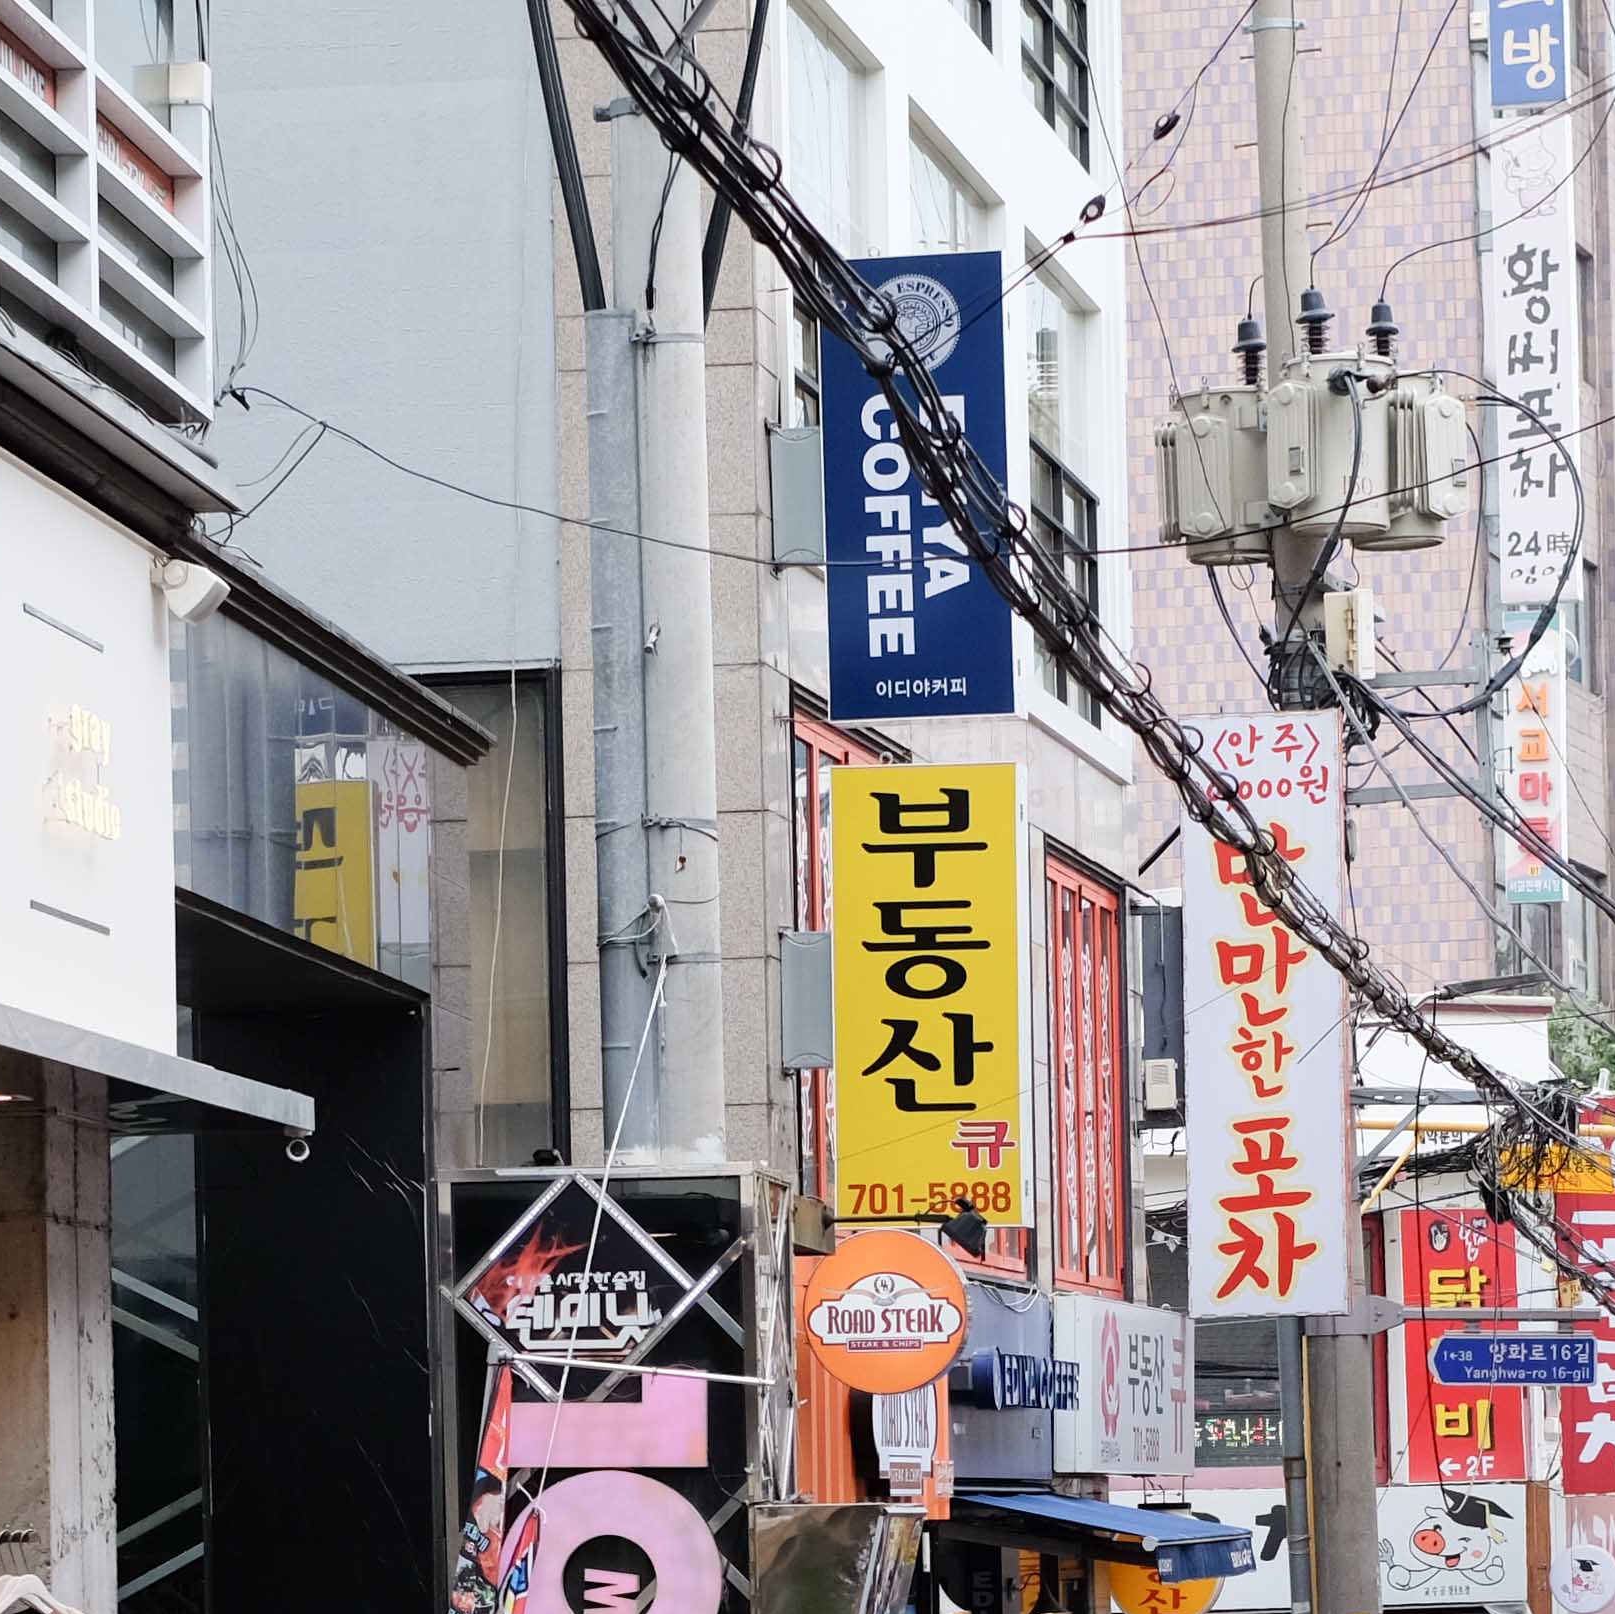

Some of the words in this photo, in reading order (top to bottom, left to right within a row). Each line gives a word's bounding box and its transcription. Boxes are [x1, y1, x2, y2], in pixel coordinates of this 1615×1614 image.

[1497, 0, 1559, 90] 방
[859, 392, 916, 660] COFFEE
[875, 677, 968, 698] 이디야커피
[861, 787, 994, 1112] 부동산
[1213, 821, 1309, 1100] 만만한
[950, 1119, 1016, 1169] 큐
[847, 1181, 1012, 1216] 701-5888
[1216, 1115, 1318, 1303] 포차
[826, 1303, 876, 1335] ROAD
[881, 1302, 944, 1334] STEAK
[848, 1339, 880, 1349] STEAK
[891, 1339, 921, 1349] CHIPS
[1004, 1353, 1037, 1407] EDIYA
[1127, 1333, 1165, 1417] 부동산
[1428, 1265, 1492, 1450] 닭비
[1465, 1366, 1547, 1381] Yanghwa-ro
[1552, 1366, 1590, 1381] 16-gil
[1465, 1455, 1495, 1478] 2F
